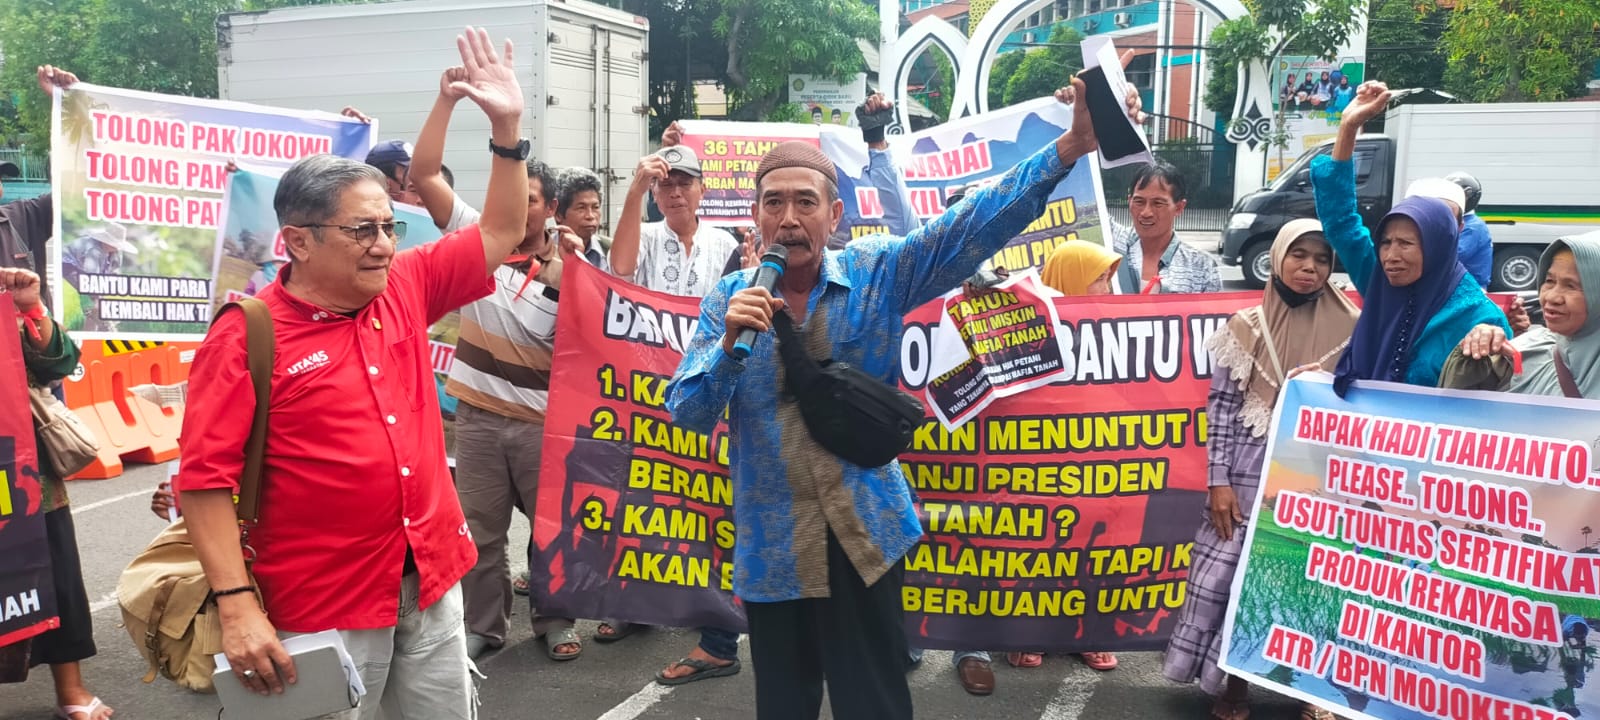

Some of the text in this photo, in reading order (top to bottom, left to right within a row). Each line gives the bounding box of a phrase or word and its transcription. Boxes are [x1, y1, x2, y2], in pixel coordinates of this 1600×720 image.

[92, 112, 329, 160] TOLONG PAK JOKOWI
[704, 140, 779, 156] 36 TAH
[86, 151, 179, 186] TOLONG
[701, 160, 722, 172] AMI
[905, 141, 989, 178] WAHAI
[703, 177, 735, 190] RBAN
[87, 190, 179, 224] TOLONG
[1020, 198, 1076, 234] ANTU
[985, 243, 1030, 271] AMI
[79, 274, 128, 294] BANTU
[130, 277, 169, 296] KAMI
[171, 278, 208, 298] PARA
[102, 300, 164, 320] KEMBALI
[167, 302, 195, 322] HAK
[948, 292, 1018, 322] TAHUN
[989, 306, 1037, 330] MISKIN
[1003, 325, 1047, 347] TANAH
[601, 368, 624, 397] 1.
[592, 411, 623, 440] 2.
[633, 416, 708, 459] KAMI
[907, 421, 975, 451] KIN
[988, 413, 1187, 451] MENUNTUT
[1298, 409, 1369, 449] BAPAK
[1369, 420, 1433, 459] HADI
[628, 459, 734, 506] BERAN
[988, 461, 1166, 494] PRESIDEN
[583, 501, 612, 531] 3.
[623, 504, 706, 542] KAMI
[924, 503, 1076, 537] TANAH ?
[1276, 493, 1340, 535] USUT
[1343, 507, 1434, 560] TUNTAS
[618, 551, 710, 588] AKAN
[1090, 546, 1163, 576] TAPI
[0, 589, 41, 623] AH
[901, 581, 1187, 617] BERJUANG UNTU
[1308, 546, 1561, 642] PRODUK REKAYASA
[1341, 603, 1484, 679] DI KANTOR
[1265, 627, 1315, 671] ATR
[1335, 649, 1388, 697] BPN
